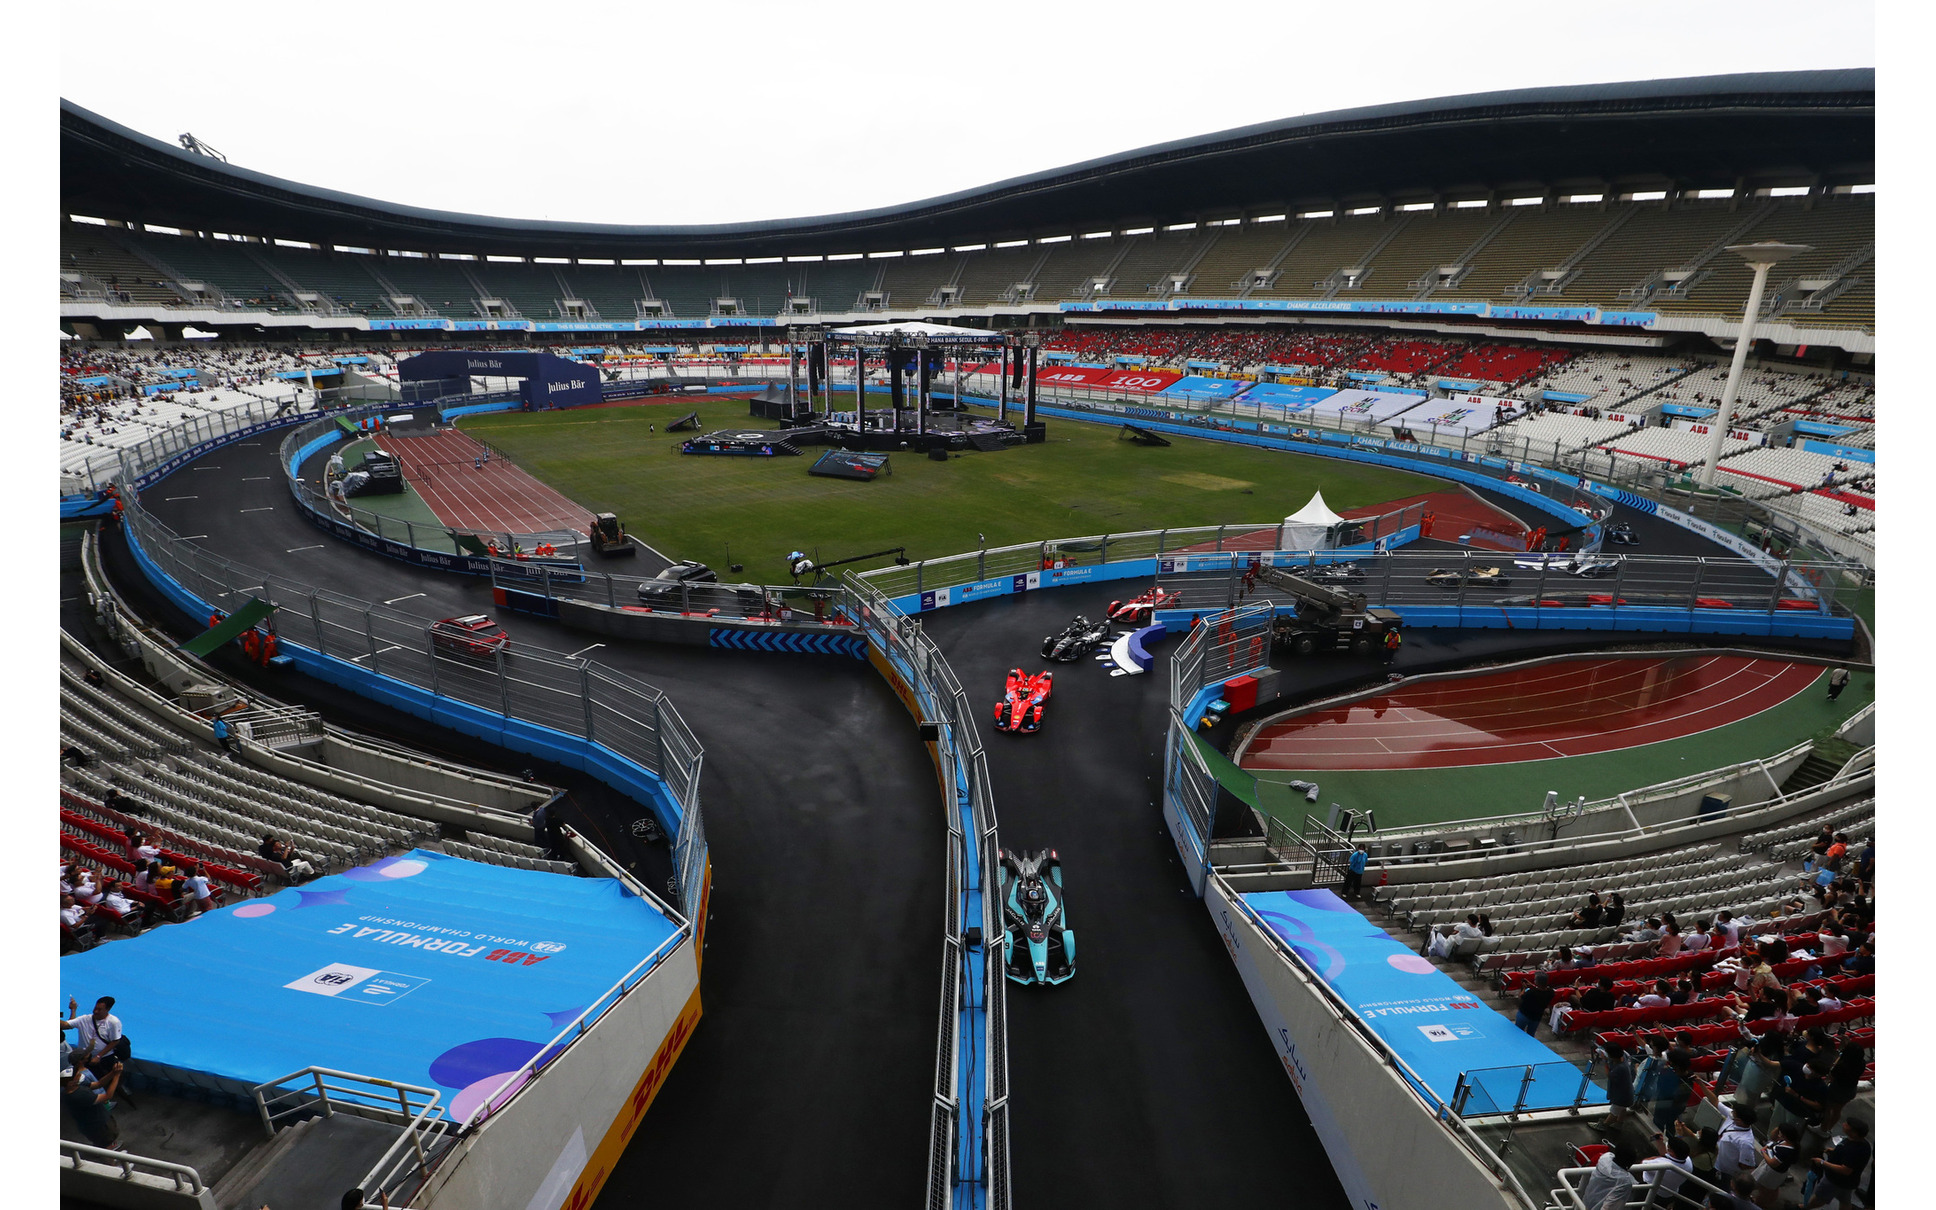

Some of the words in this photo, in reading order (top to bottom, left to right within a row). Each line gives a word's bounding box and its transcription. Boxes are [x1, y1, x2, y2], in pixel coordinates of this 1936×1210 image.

[467, 359, 488, 369] Julius
[489, 359, 502, 368] Bär
[1046, 373, 1086, 381] ABB
[1110, 376, 1162, 387] 100
[548, 381, 570, 394] Julius
[570, 379, 586, 390] Bär
[1608, 413, 1625, 422] ABB
[1690, 424, 1708, 434] ABB
[1358, 437, 1385, 447] CHANG
[1388, 441, 1440, 456] ACCELEATED.
[420, 553, 439, 565] Julius
[439, 554, 451, 566] Bär
[468, 560, 489, 571] Julius
[973, 583, 997, 591] FORMULA
[890, 672, 908, 700] DHL
[1006, 908, 1025, 926] JAGUAR
[326, 923, 358, 934] E
[358, 915, 468, 938] CHAMPIONSHIP
[352, 926, 487, 957] FORMULA
[474, 934, 530, 947] WORLD
[484, 948, 551, 966] ABB
[1358, 998, 1421, 1008] CHAMPIONSHIP
[1376, 1003, 1449, 1016] FORMULA
[1449, 1002, 1480, 1010] ABB
[1363, 1010, 1377, 1019] E
[1278, 1027, 1306, 1081] سابك
[632, 1016, 689, 1122] DHL
[1282, 1055, 1302, 1097] sabic
